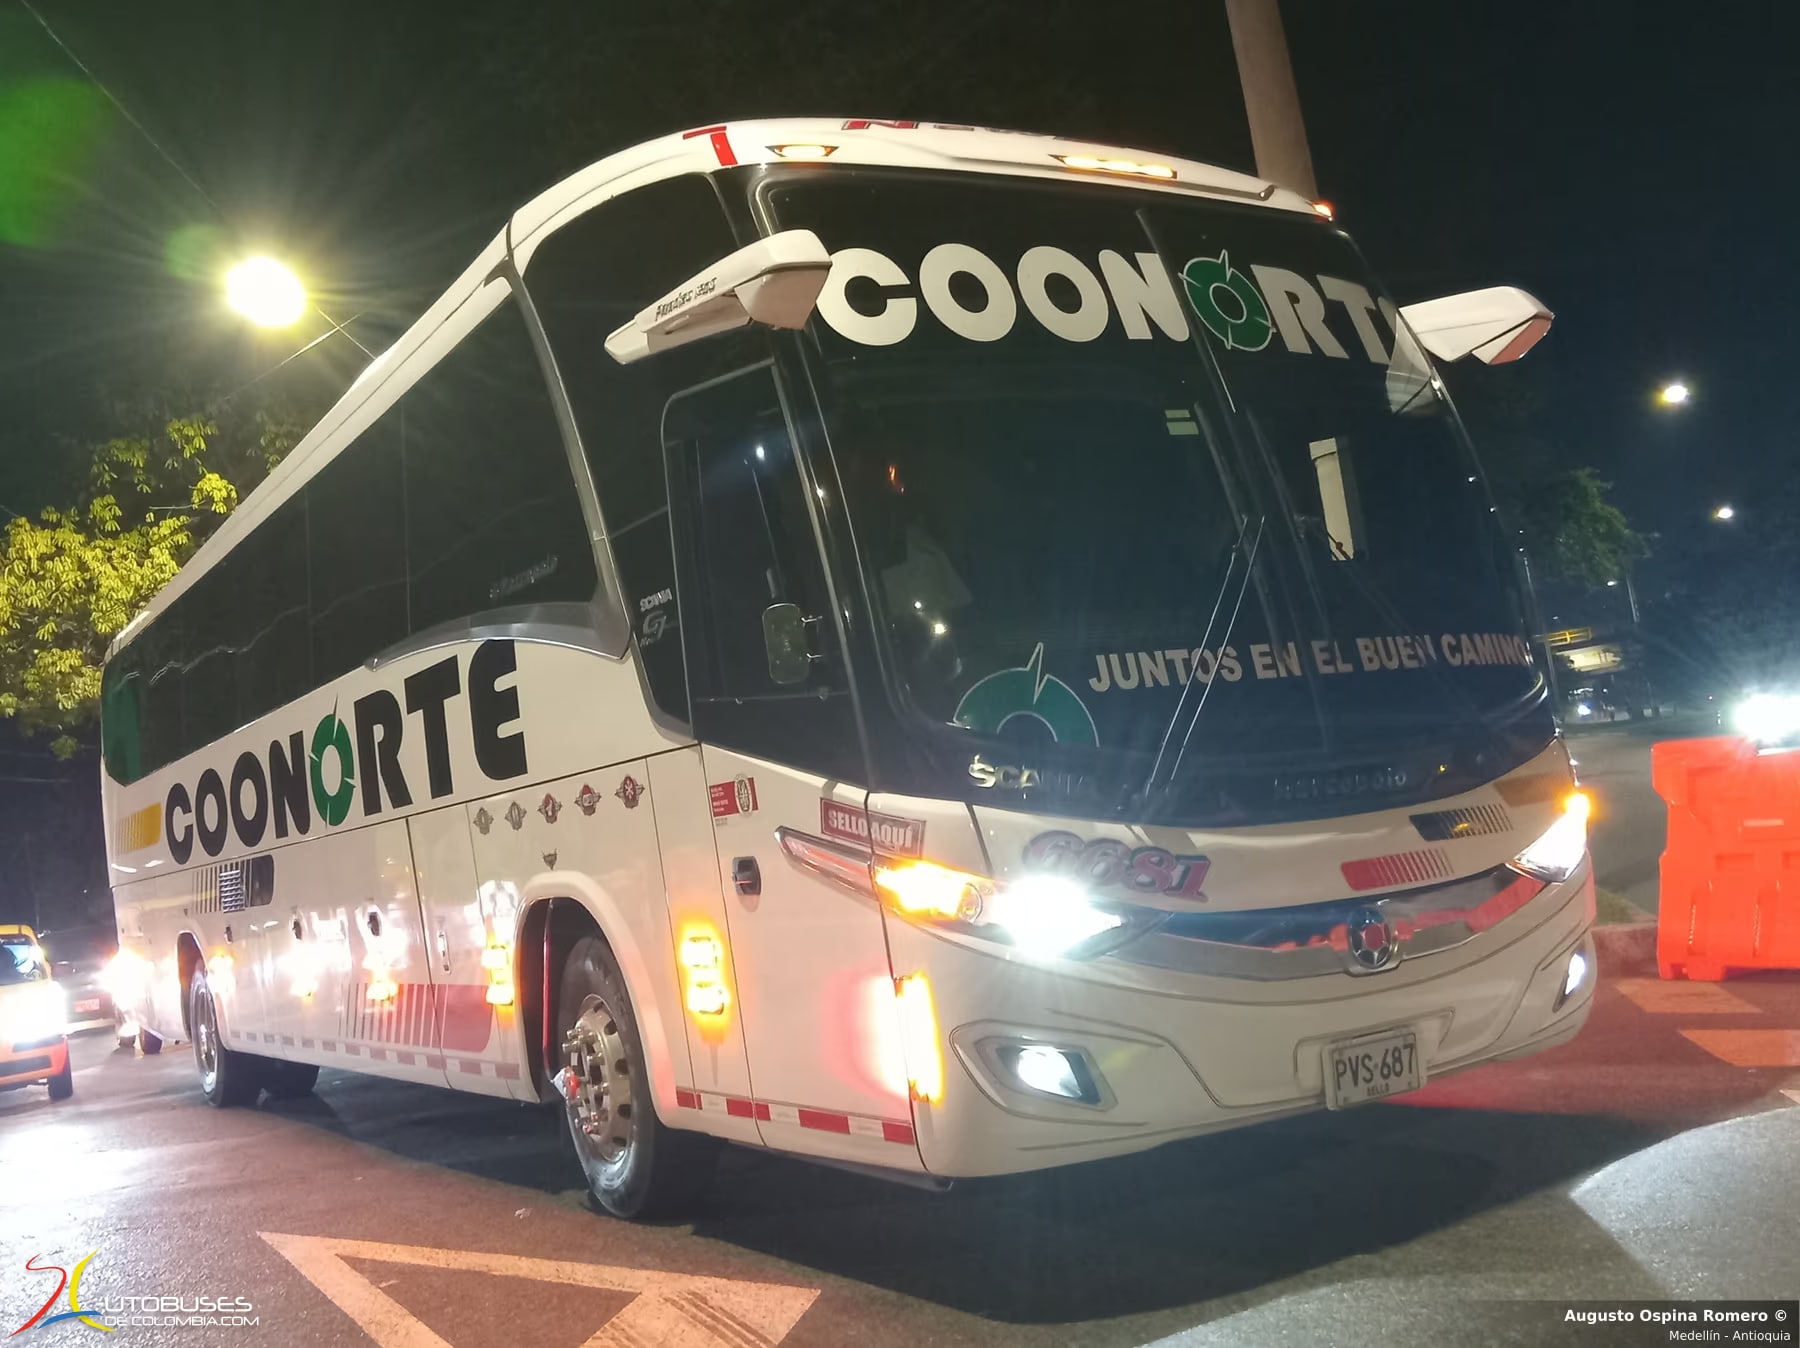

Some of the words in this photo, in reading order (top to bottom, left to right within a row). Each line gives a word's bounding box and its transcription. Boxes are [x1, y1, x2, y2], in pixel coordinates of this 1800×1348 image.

[815, 243, 1397, 365] COONORT
[1088, 645, 1243, 692] JUNTOS
[1250, 641, 1302, 680] EN
[1310, 639, 1354, 675] EL
[1355, 634, 1437, 672] BUEN
[1440, 632, 1533, 667] CAMINO
[165, 639, 529, 865] COONORTE
[828, 810, 867, 836] SELLO
[871, 822, 913, 849] AQUÍ
